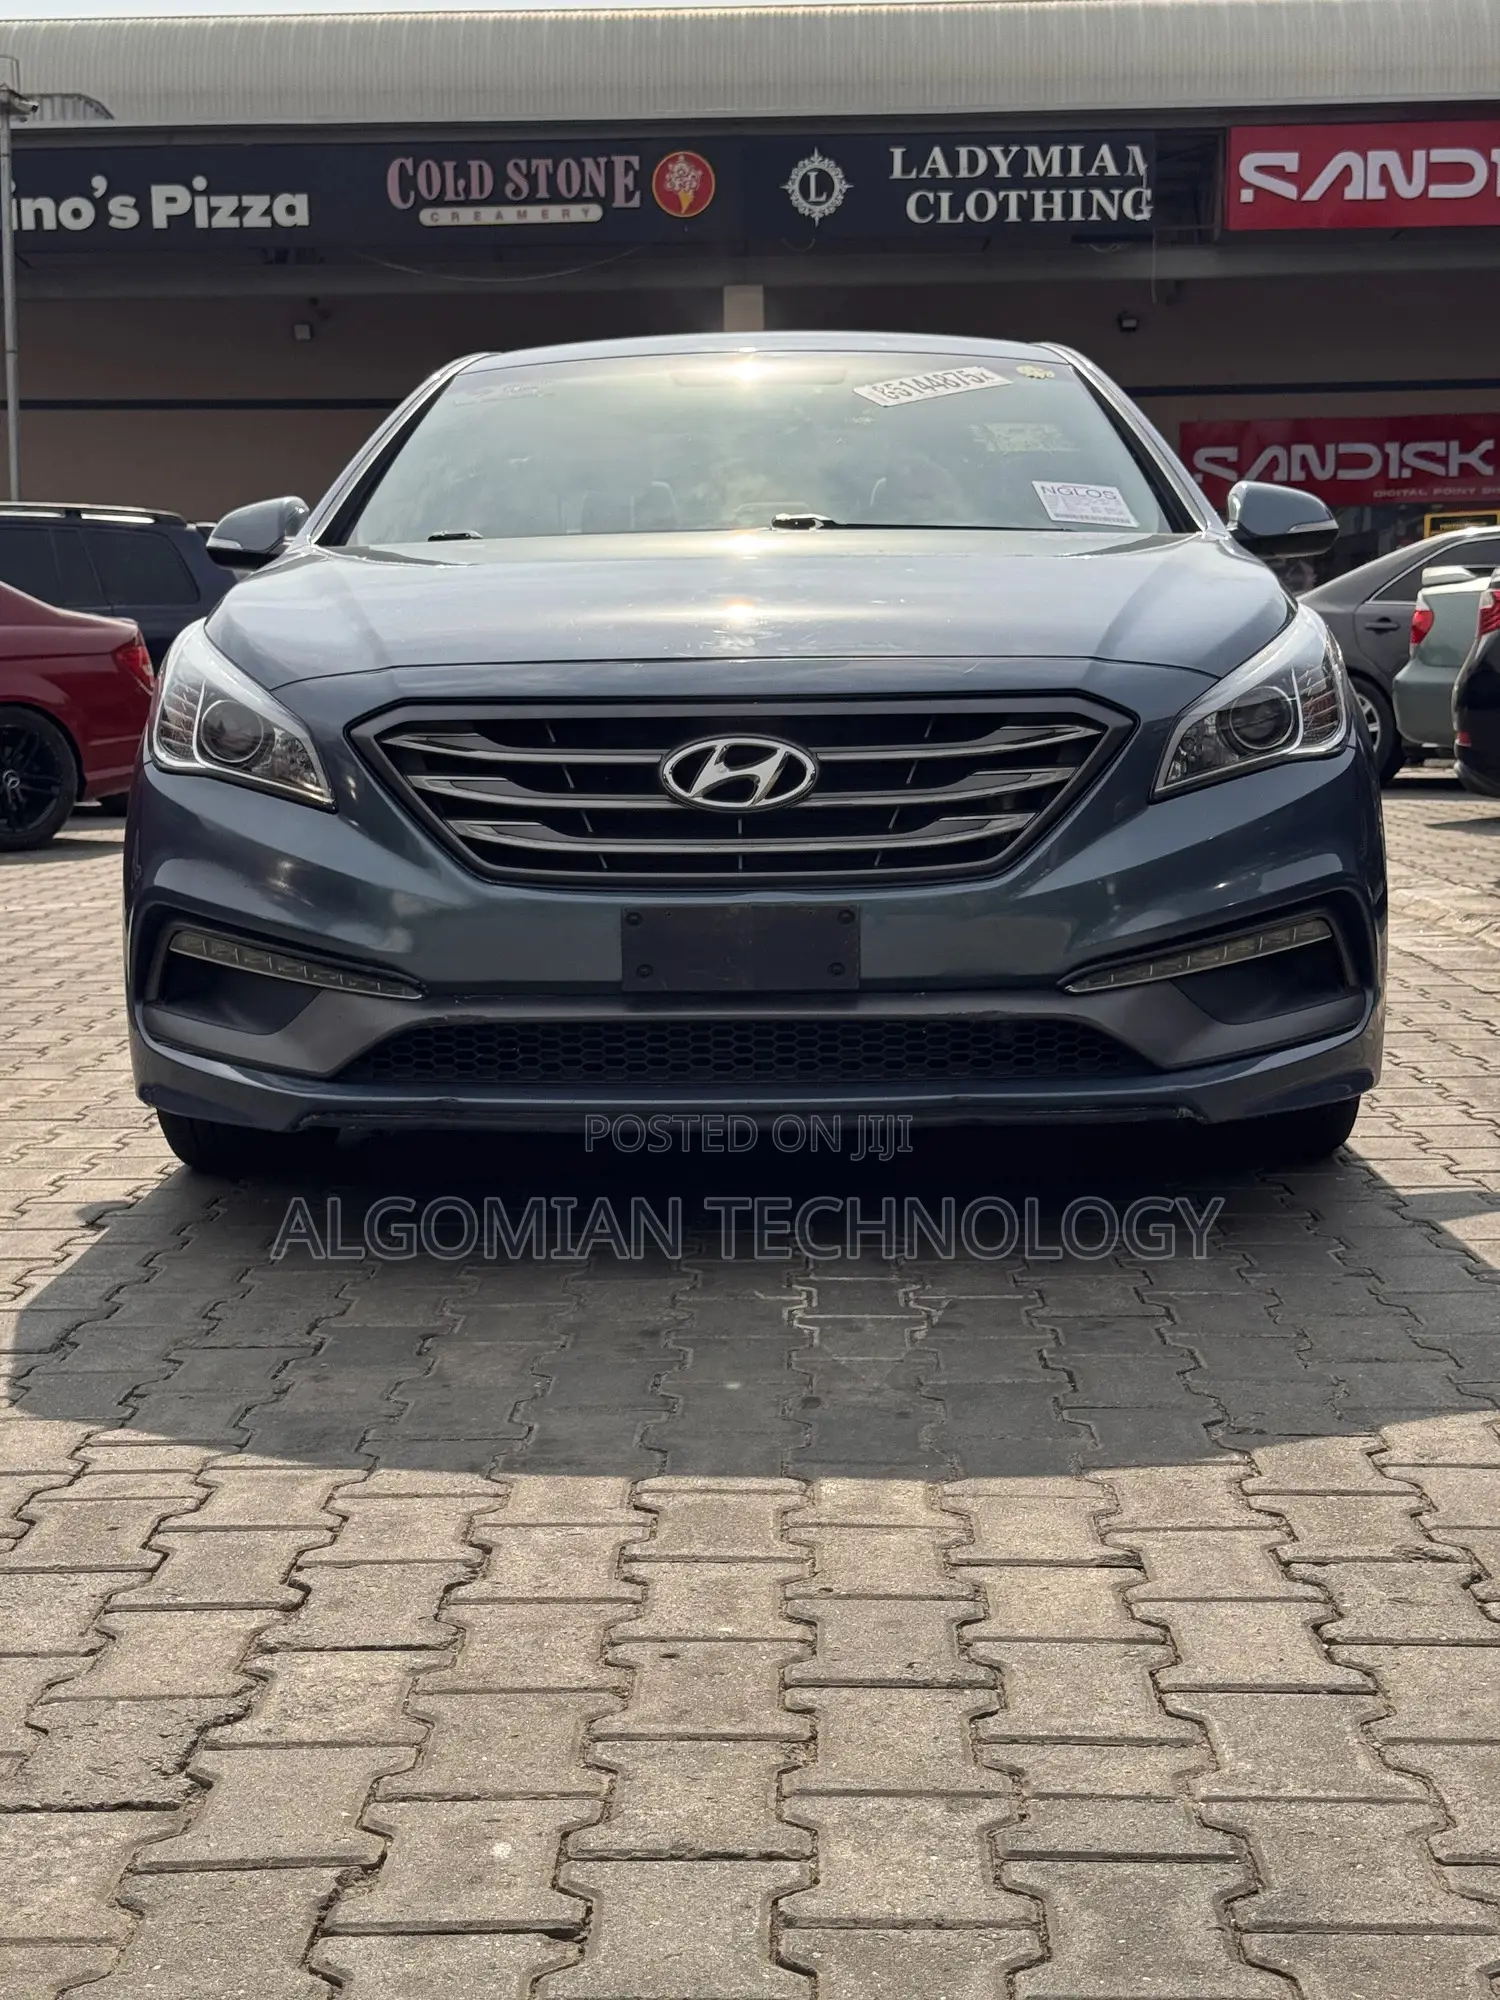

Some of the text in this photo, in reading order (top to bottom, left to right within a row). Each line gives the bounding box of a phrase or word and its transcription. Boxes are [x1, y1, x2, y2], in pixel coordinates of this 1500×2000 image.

[386, 154, 641, 210] COLD STONE
[807, 171, 827, 202] L
[150, 175, 310, 231] Pizza
[430, 206, 590, 223] CREAMERY
[905, 187, 1154, 224] CLOTHING
[1193, 439, 1494, 482] SANDISK
